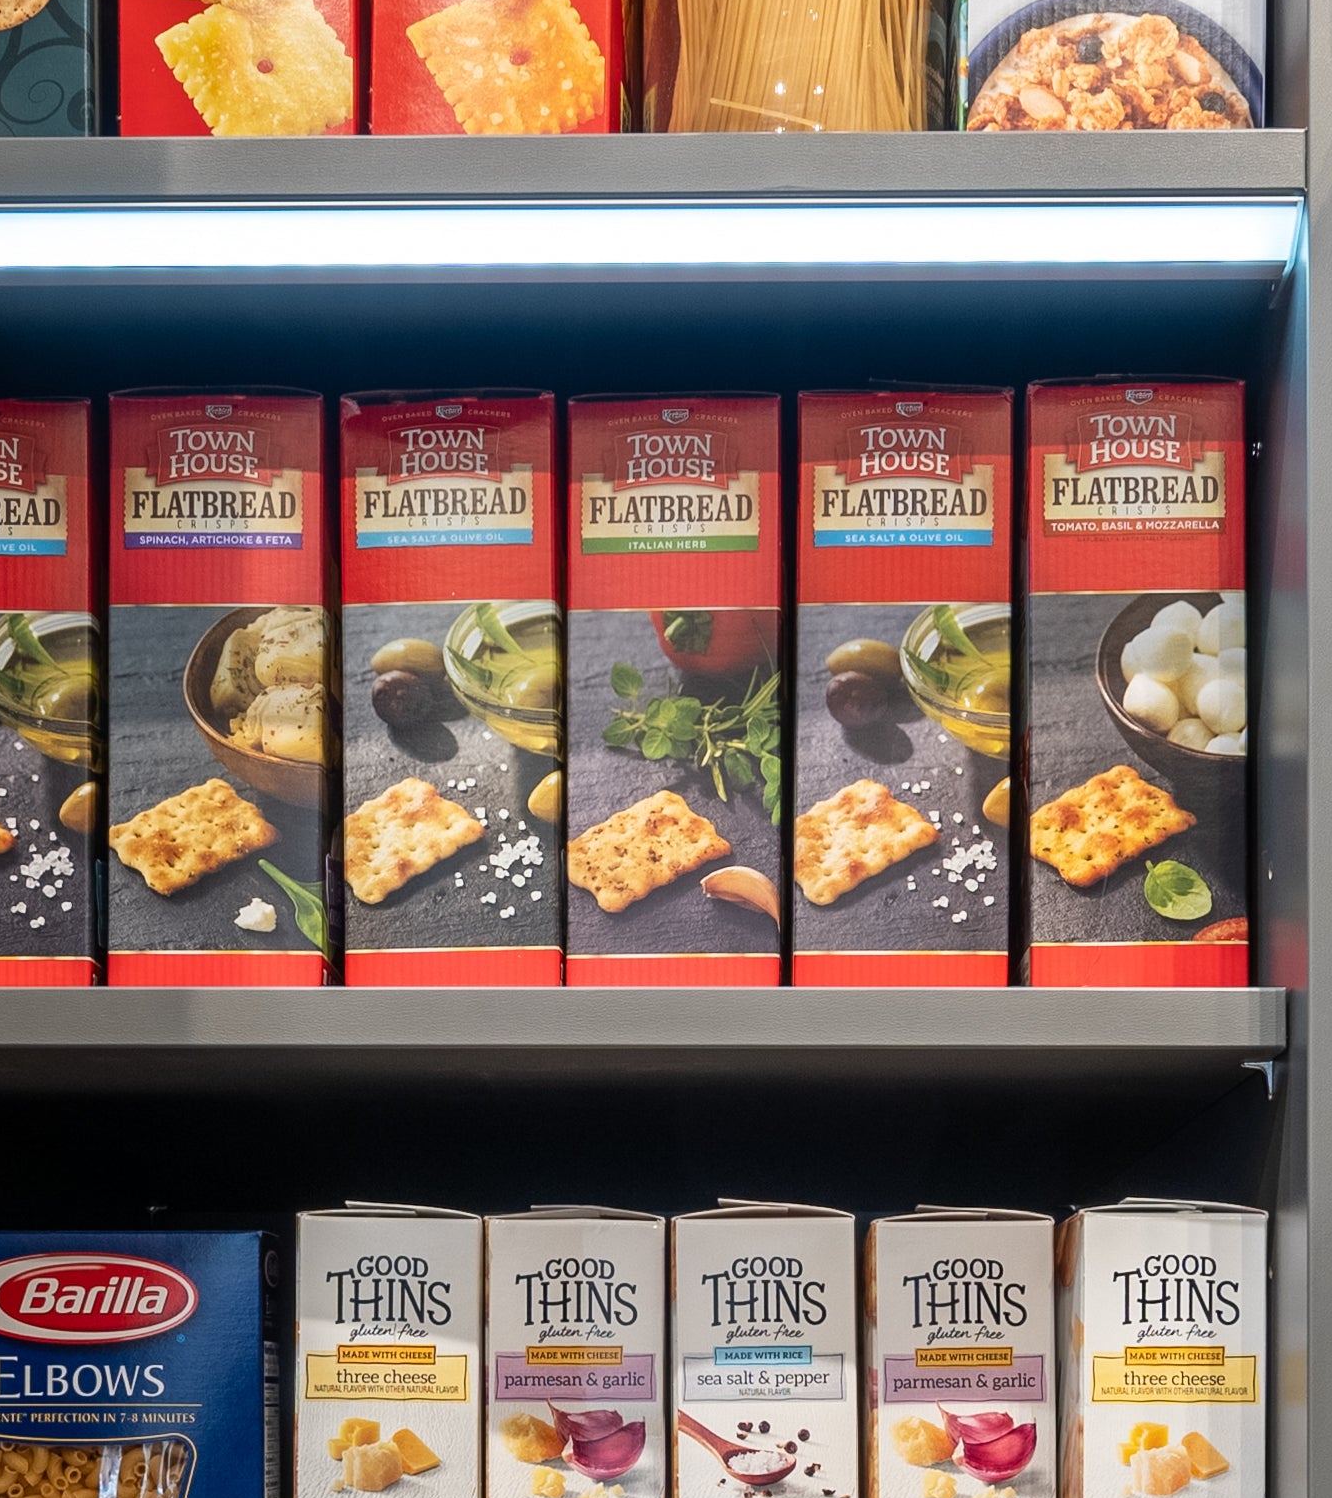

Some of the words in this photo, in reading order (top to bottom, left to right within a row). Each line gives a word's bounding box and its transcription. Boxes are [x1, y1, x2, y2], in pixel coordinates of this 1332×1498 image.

[860, 426, 946, 450] TOWN
[1090, 414, 1176, 438] TOWN
[169, 429, 255, 454] TOWN
[400, 428, 485, 452] TOWN
[627, 433, 711, 458] TOWN
[1090, 438, 1180, 464] HOUSE
[169, 453, 258, 478] HOUSE
[400, 451, 488, 477] HOUSE
[627, 457, 715, 483] HOUSE
[859, 451, 949, 477] HOUSE
[364, 487, 526, 519] FLATBREAD
[822, 489, 987, 516] FLATBREAD
[1052, 476, 1218, 506] FLATBREAD
[132, 491, 296, 519] FLATBREAD
[589, 494, 753, 524] FLATBREAD
[139, 535, 188, 545] SPINACH,
[192, 535, 252, 545] ARTICHOKE
[256, 536, 263, 544] &
[266, 536, 292, 545] FETA
[628, 541, 670, 549] ITALIAN
[673, 540, 707, 549] HERB
[357, 1255, 428, 1277] GOOD
[545, 1258, 615, 1279] GOOD
[732, 1257, 803, 1278] GOOD
[933, 1258, 1004, 1280] GOOD
[1144, 1255, 1217, 1277] GOOD
[19, 1277, 168, 1314] Barilla
[327, 1268, 451, 1325] THINS
[516, 1271, 637, 1326] THINS
[702, 1270, 827, 1327] THINS
[903, 1272, 1027, 1328] THINS
[1113, 1268, 1240, 1326] THINS
[350, 1326, 394, 1341] gluten
[397, 1324, 428, 1338] free
[337, 1369, 380, 1384] three
[383, 1371, 436, 1384] cheese
[697, 1373, 723, 1385] sea
[727, 1371, 755, 1385] salt
[759, 1371, 770, 1385] &
[774, 1372, 829, 1390] pepper
